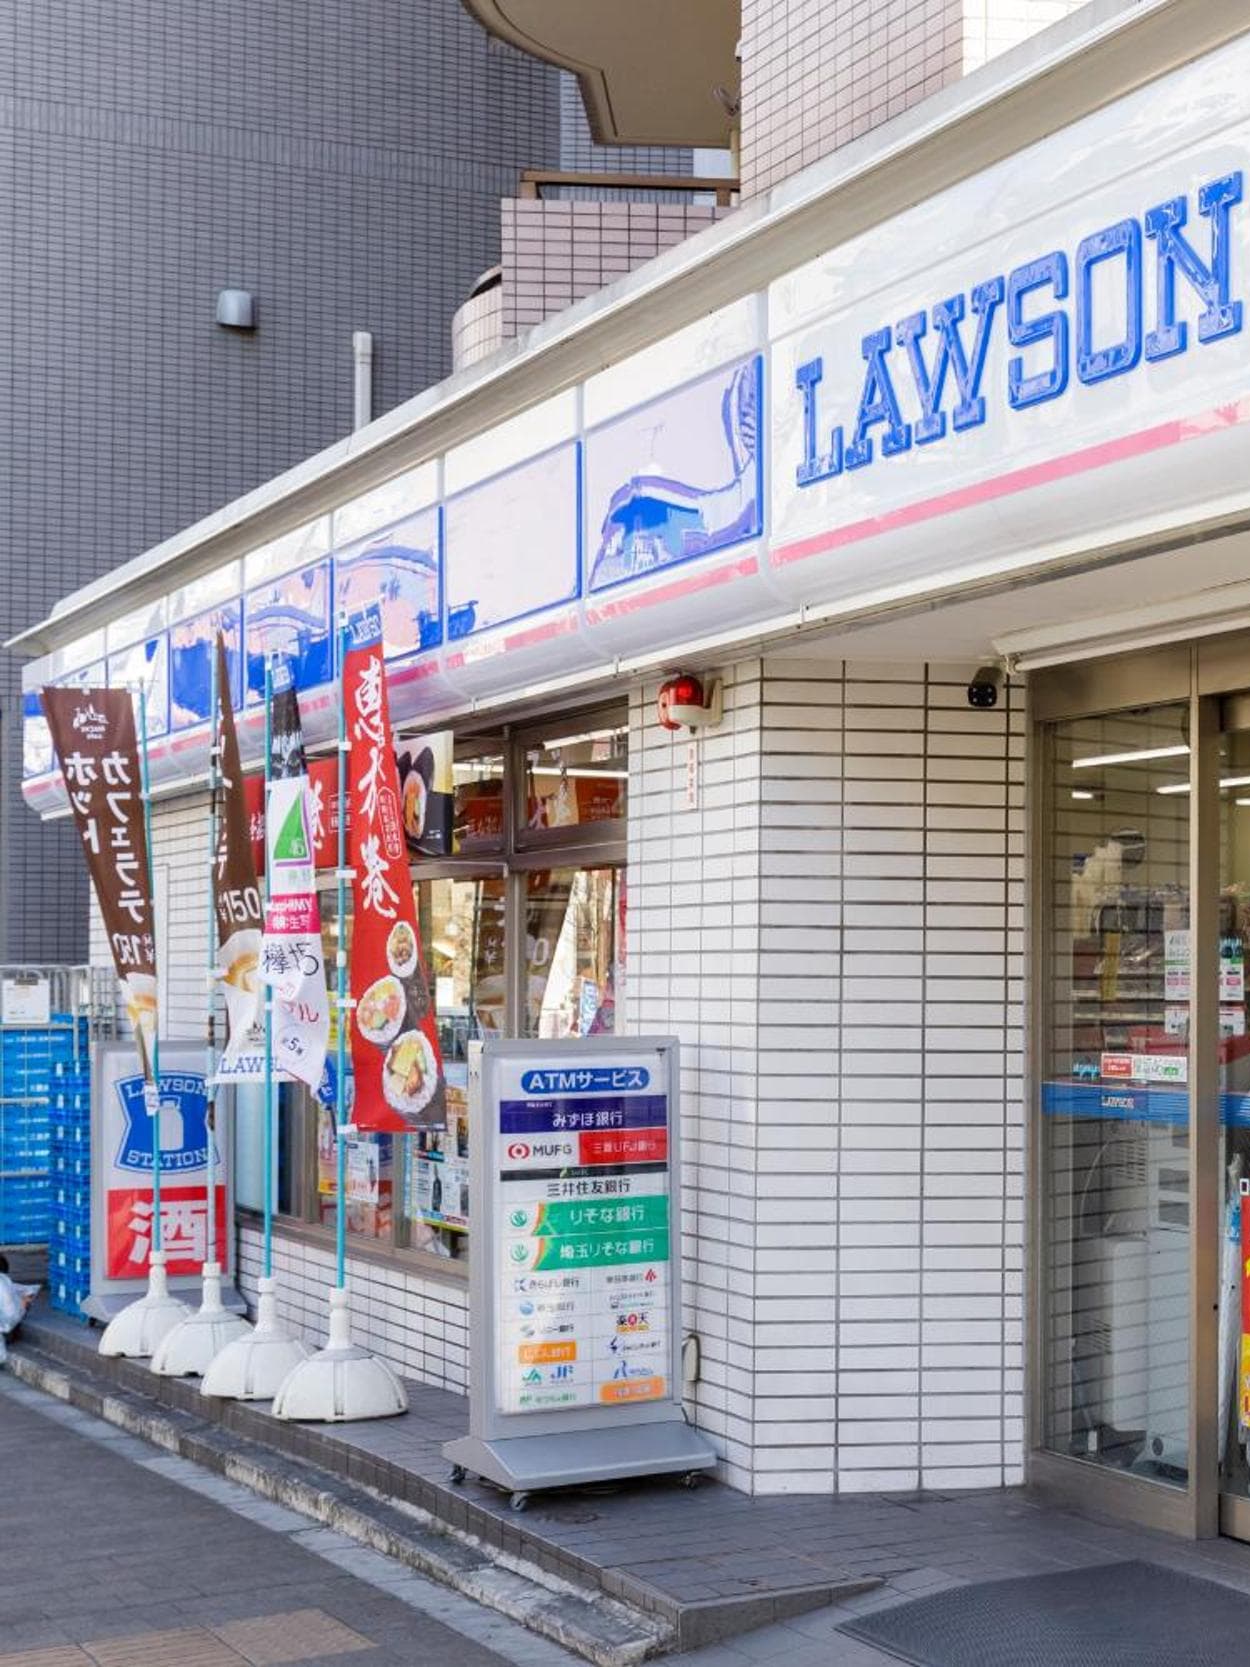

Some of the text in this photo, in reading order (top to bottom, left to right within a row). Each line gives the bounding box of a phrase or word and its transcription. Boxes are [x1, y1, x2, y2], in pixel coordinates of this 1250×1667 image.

[795, 170, 1243, 488] LAWSON
[124, 1078, 209, 1098] LWSON
[529, 1069, 644, 1090] ATMサービス
[552, 1111, 623, 1128] みずほ銀行
[532, 1143, 572, 1157] MUFG
[547, 1178, 631, 1198] 三井住友銀行
[569, 1204, 646, 1226] りそな銀行
[128, 1198, 208, 1265] 酒
[560, 1238, 655, 1259] 埼玉りそな銀行
